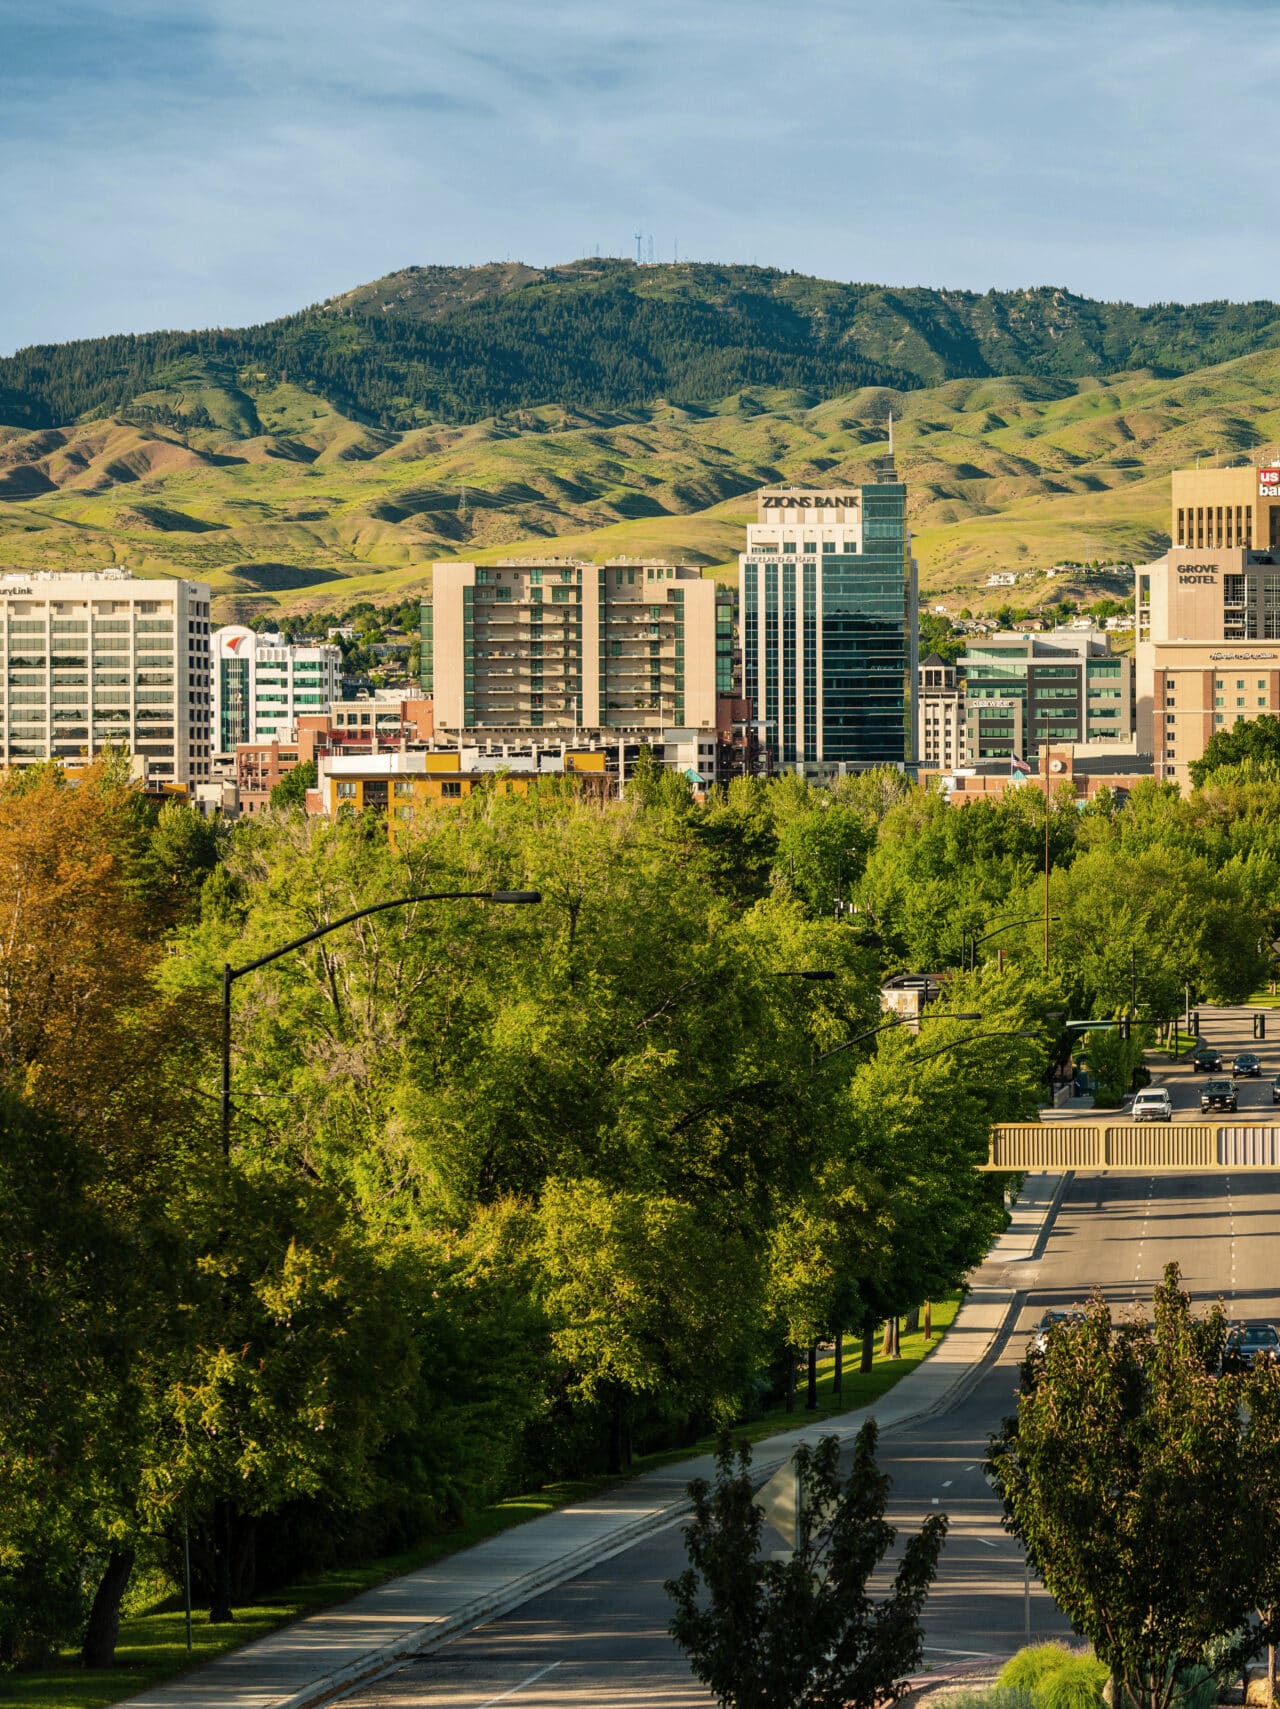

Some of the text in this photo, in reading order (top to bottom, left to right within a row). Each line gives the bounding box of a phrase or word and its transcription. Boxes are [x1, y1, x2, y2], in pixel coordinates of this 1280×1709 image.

[1260, 471, 1279, 482] us
[762, 496, 860, 508] ZIONS BANK
[1177, 564, 1220, 573] GROVE
[1179, 575, 1218, 584] HOTEL
